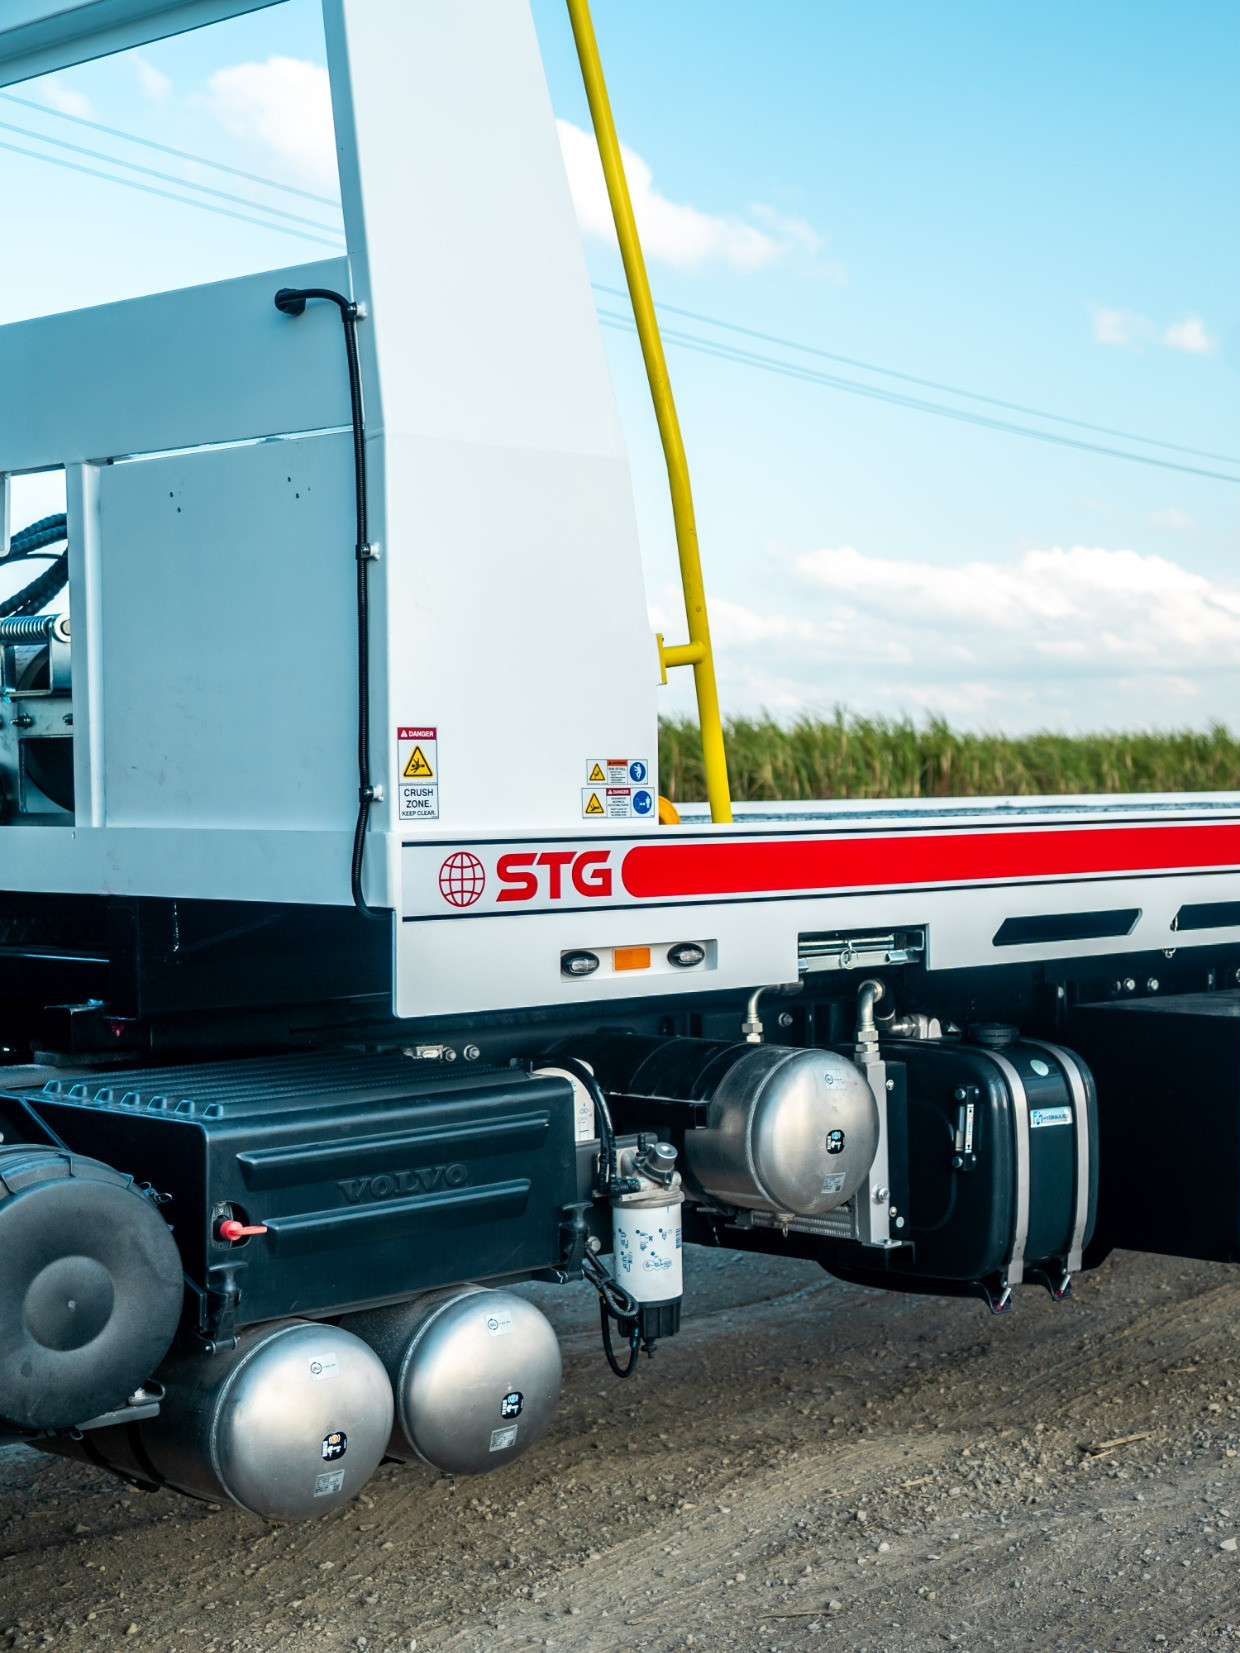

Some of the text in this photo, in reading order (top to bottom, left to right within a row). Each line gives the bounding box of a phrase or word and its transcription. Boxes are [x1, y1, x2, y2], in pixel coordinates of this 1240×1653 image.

[404, 789, 433, 797] CRUSH
[406, 800, 432, 808] ZONE.
[496, 850, 612, 902] STG
[337, 1163, 469, 1203] VOLVO
